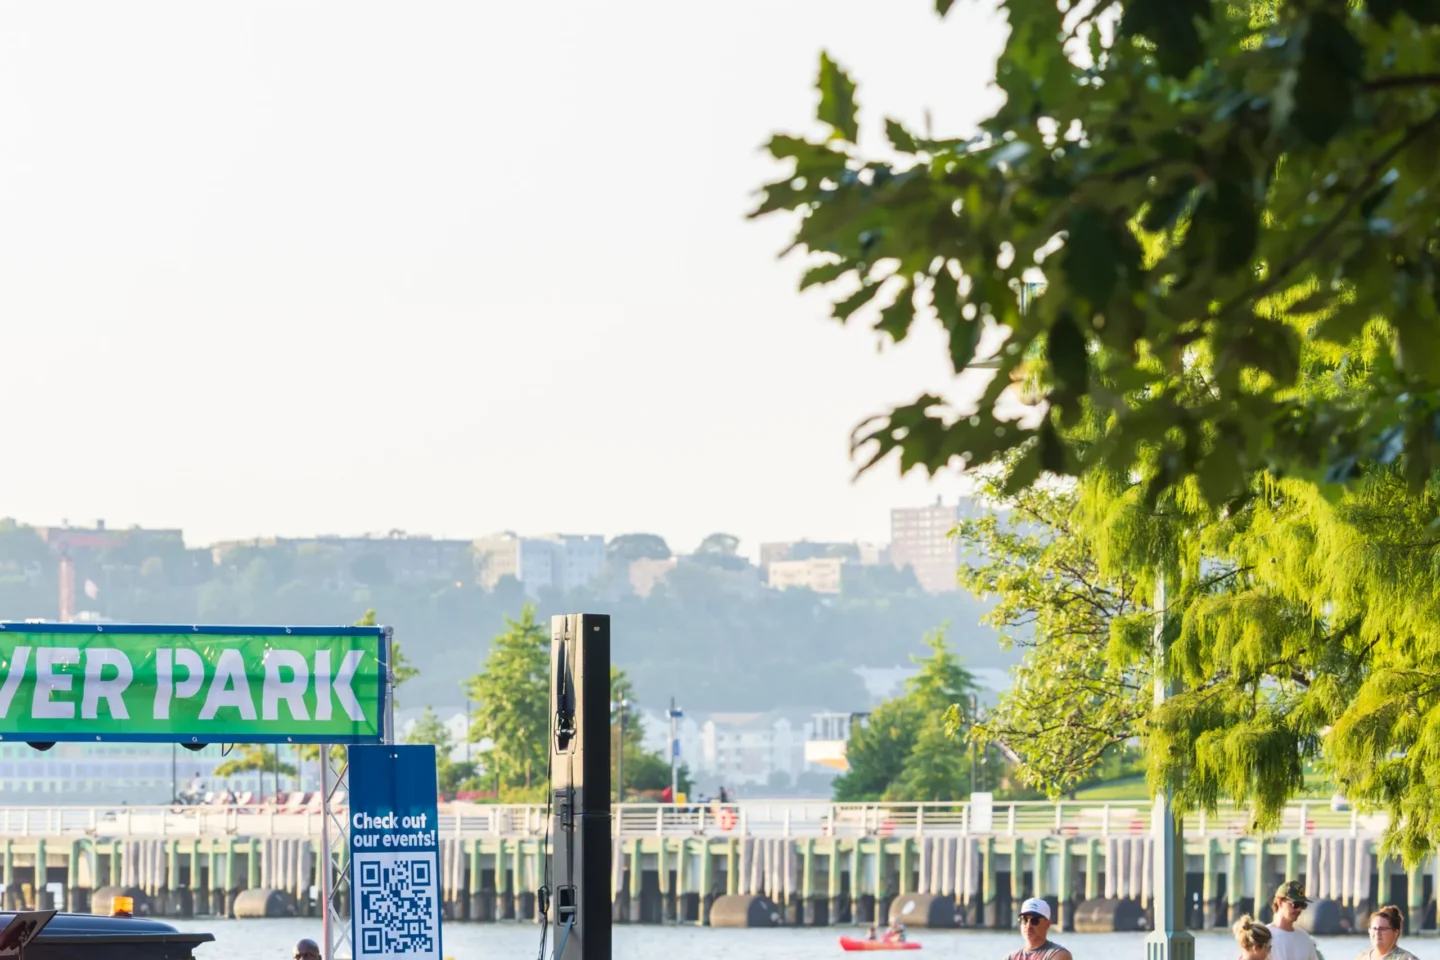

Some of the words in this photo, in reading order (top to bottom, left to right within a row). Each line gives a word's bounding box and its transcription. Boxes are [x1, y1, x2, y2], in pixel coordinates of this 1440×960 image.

[154, 648, 366, 721] PARK
[353, 811, 399, 830] Check
[402, 812, 427, 829] out
[353, 833, 380, 848] our
[382, 829, 436, 847] events!
